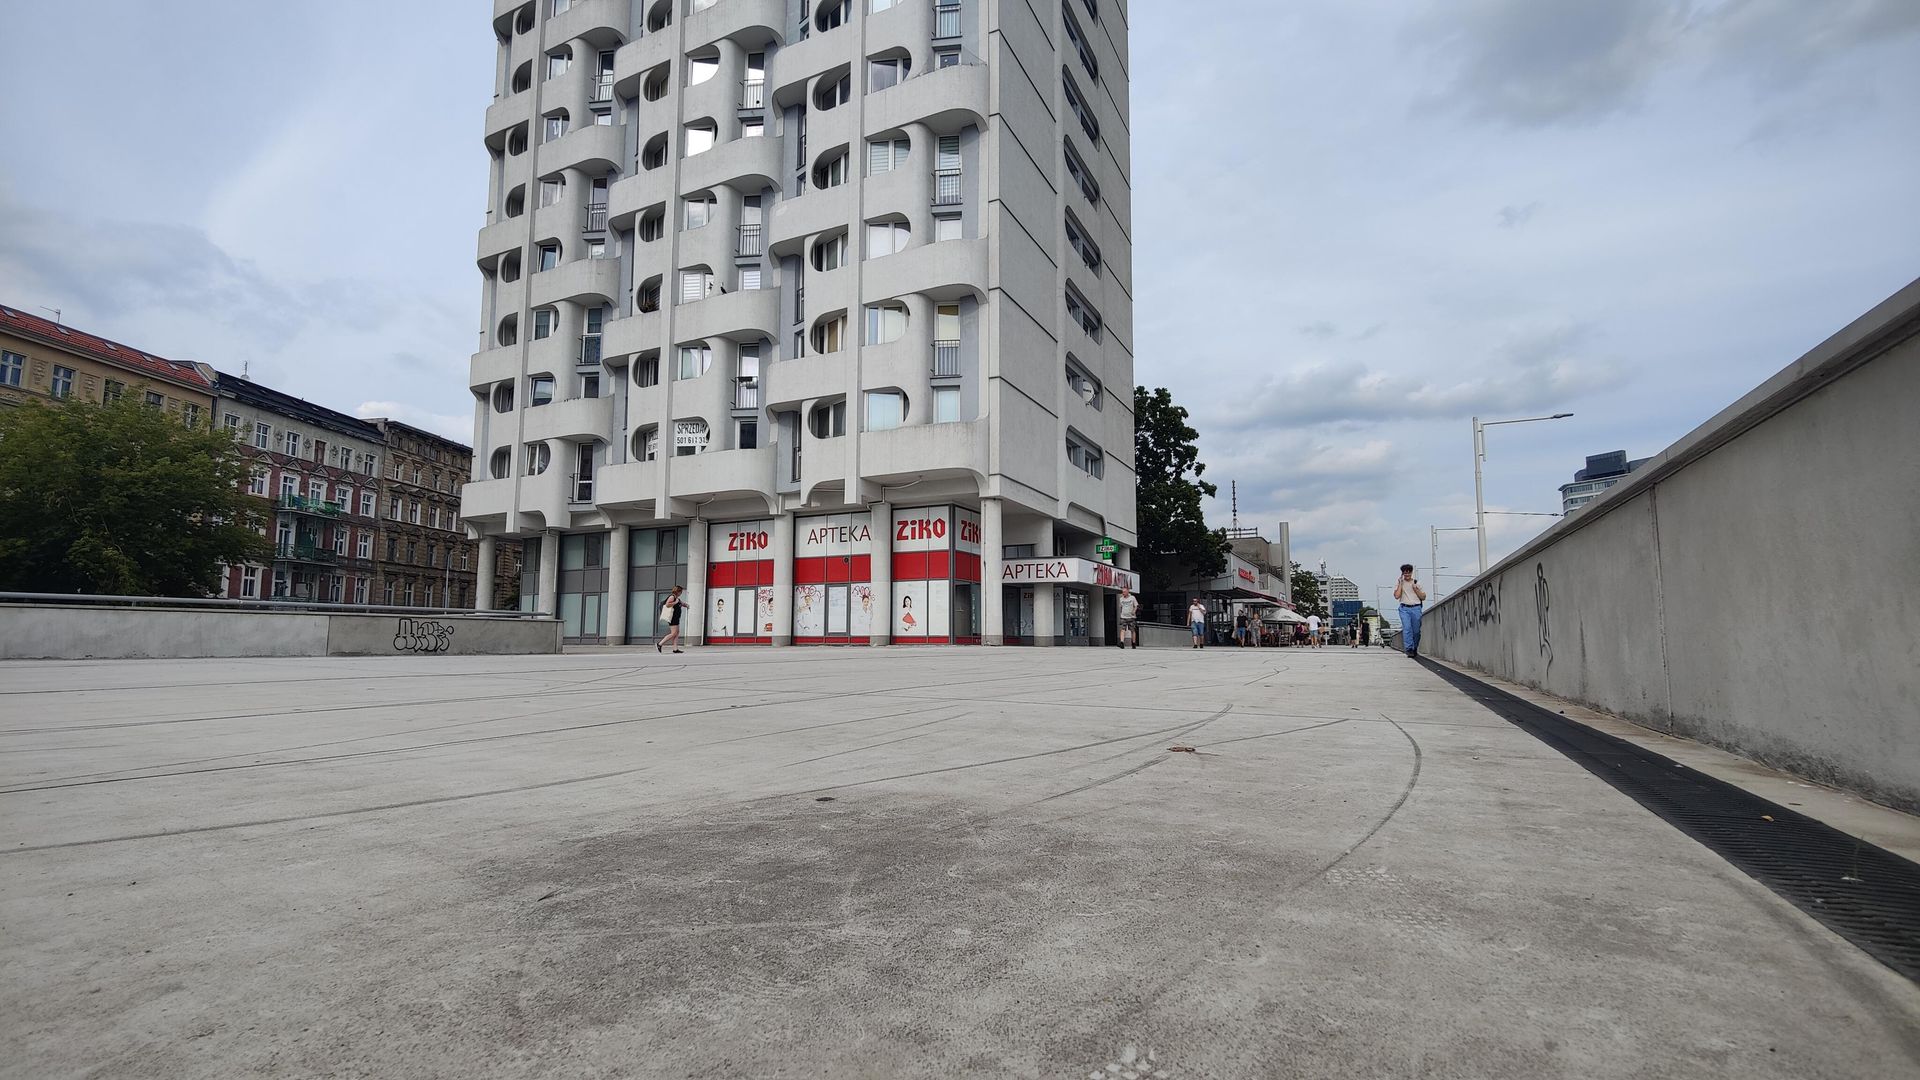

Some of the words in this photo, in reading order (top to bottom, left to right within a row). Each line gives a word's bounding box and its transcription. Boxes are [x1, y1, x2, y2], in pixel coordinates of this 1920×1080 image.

[807, 525, 872, 545] APTEKA
[896, 517, 946, 541] ZiKO
[961, 520, 981, 544] ZiK
[728, 530, 769, 551] ZiKO
[1002, 562, 1069, 579] APTEKA
